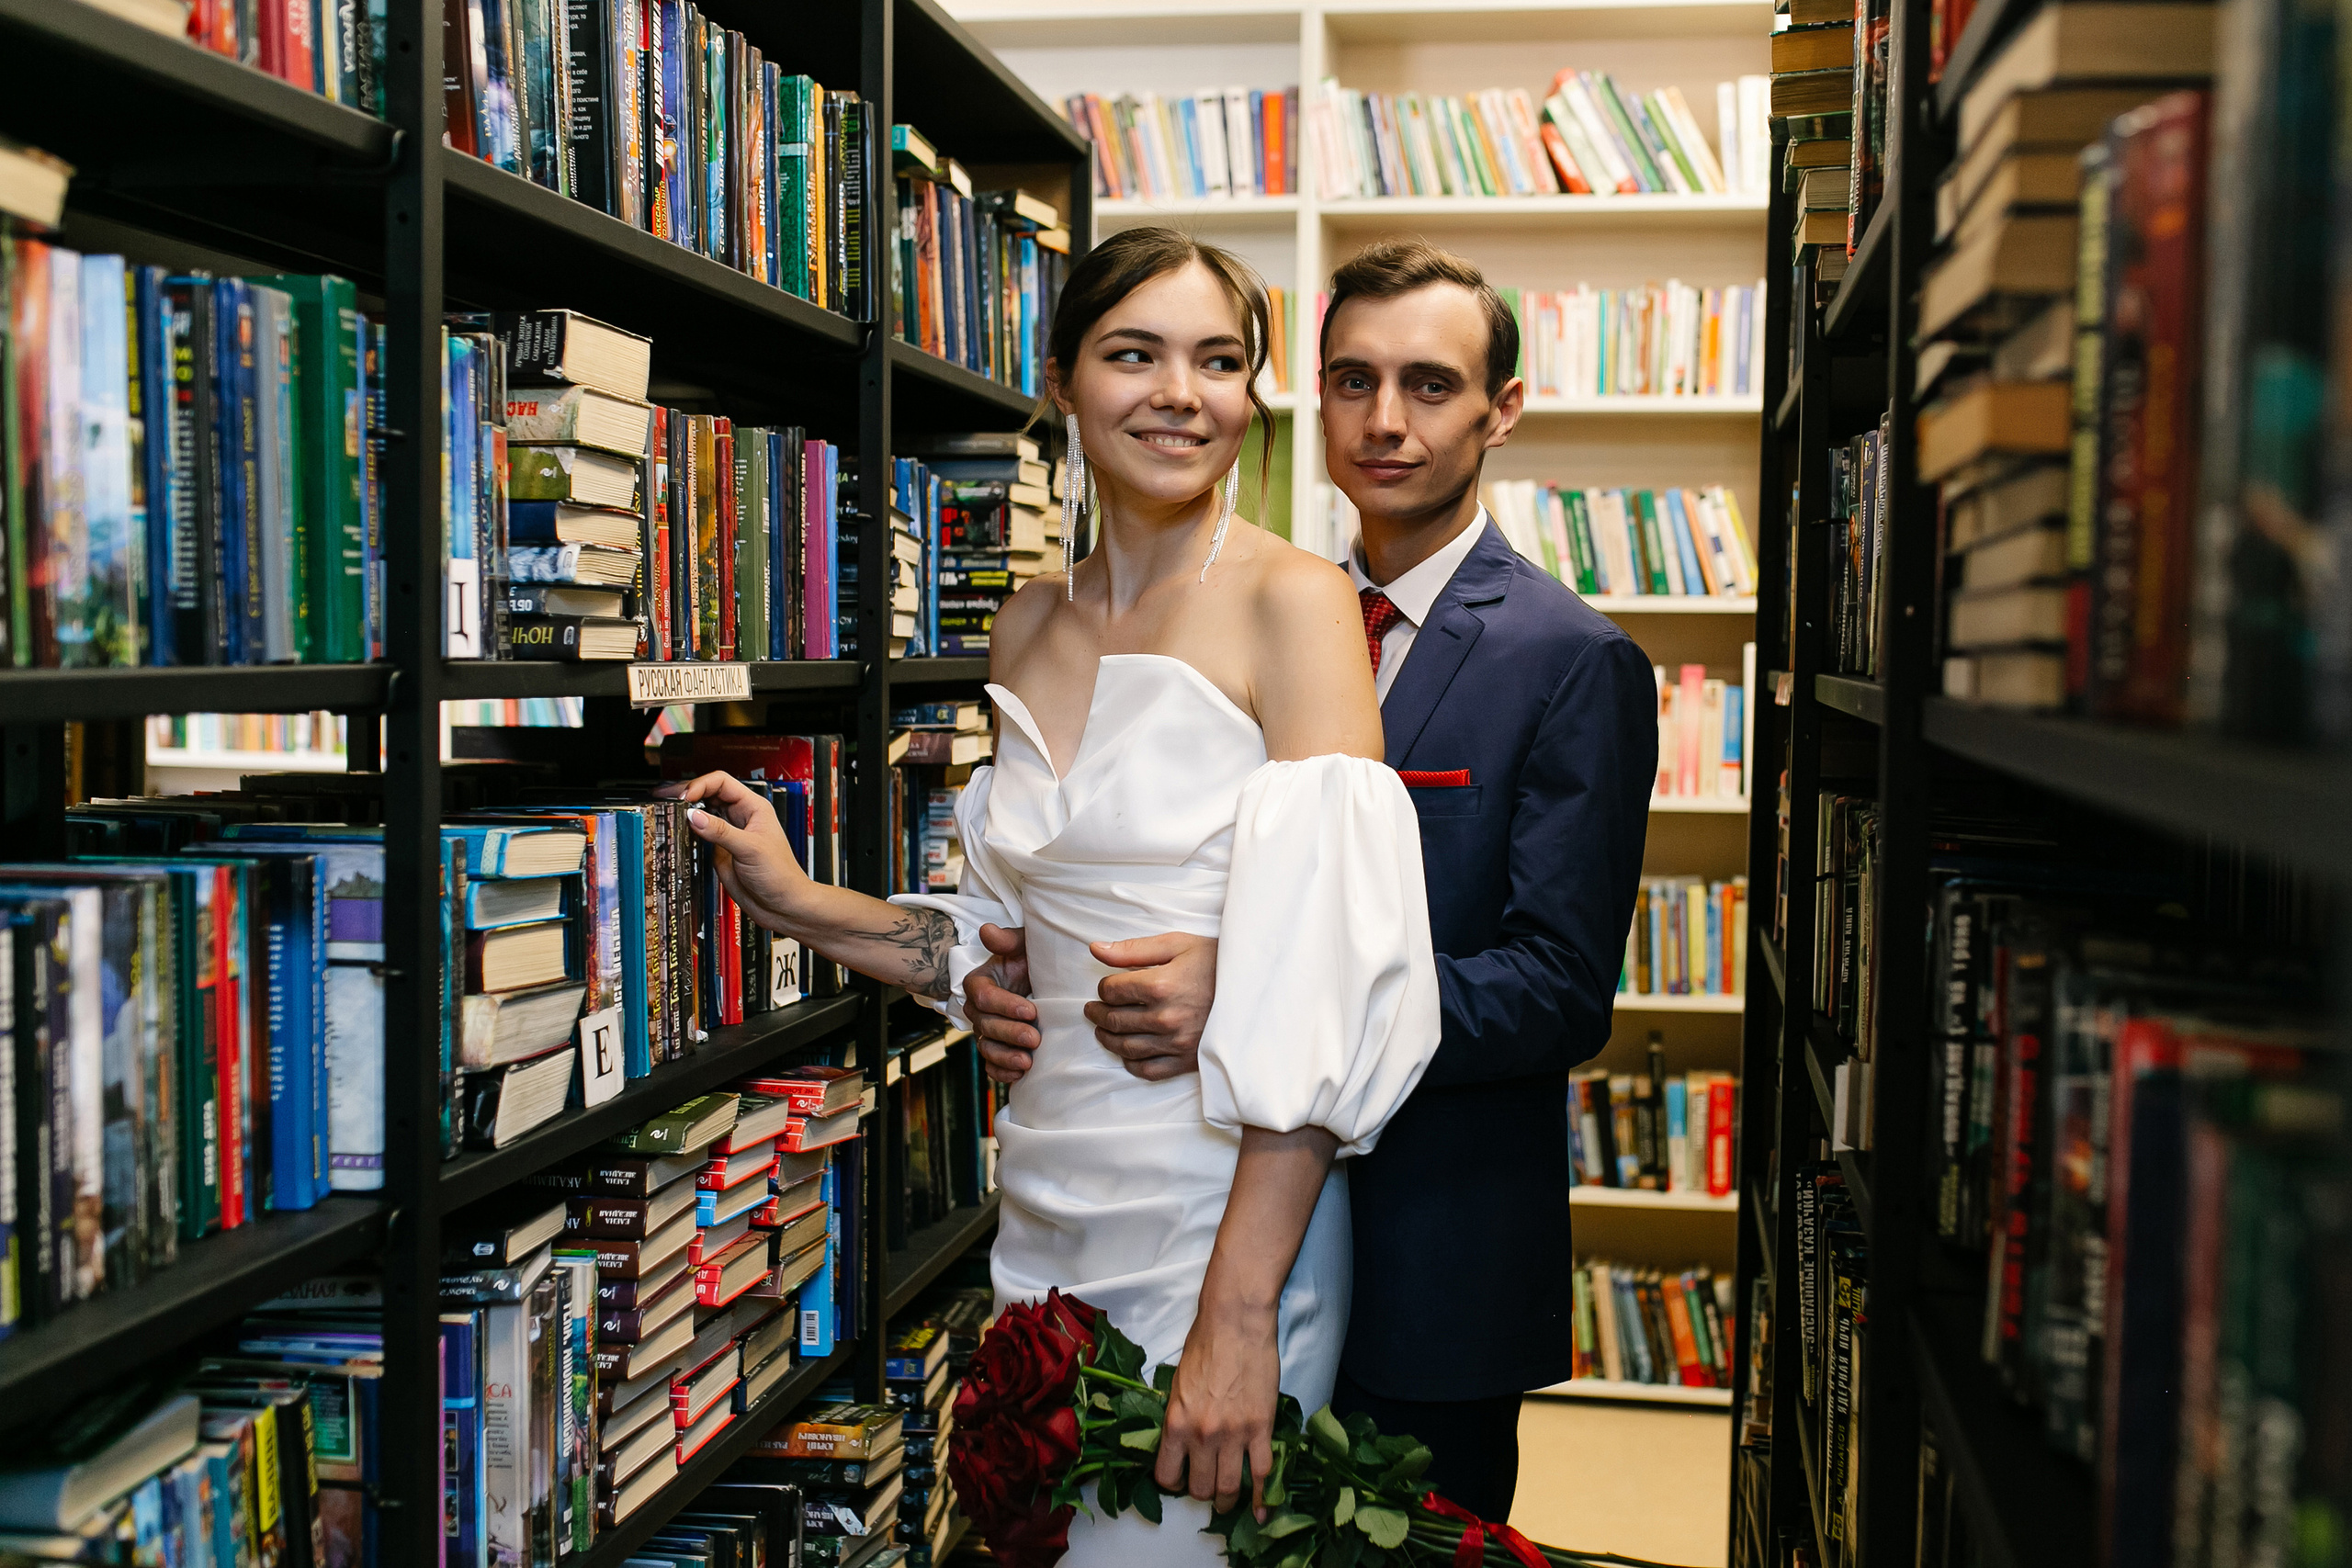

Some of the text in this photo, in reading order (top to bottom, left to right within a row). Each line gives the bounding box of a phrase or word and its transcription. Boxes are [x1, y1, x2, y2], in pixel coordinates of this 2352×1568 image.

[651, 0, 665, 169] НОЖ РАЗВЕДЧИКА
[531, 321, 541, 363] САБОТАЖНИК
[638, 668, 743, 697] РУССКАЯ ФАНТАСТИКА
[609, 907, 622, 975] НЕБЕСА
[733, 902, 741, 947] АНДРЕЙ
[775, 952, 797, 990] Ж
[592, 1025, 615, 1080] Е
[600, 1170, 636, 1179] ЗВЕЗДНАЯ
[1838, 1318, 1850, 1350] НОЧЬ
